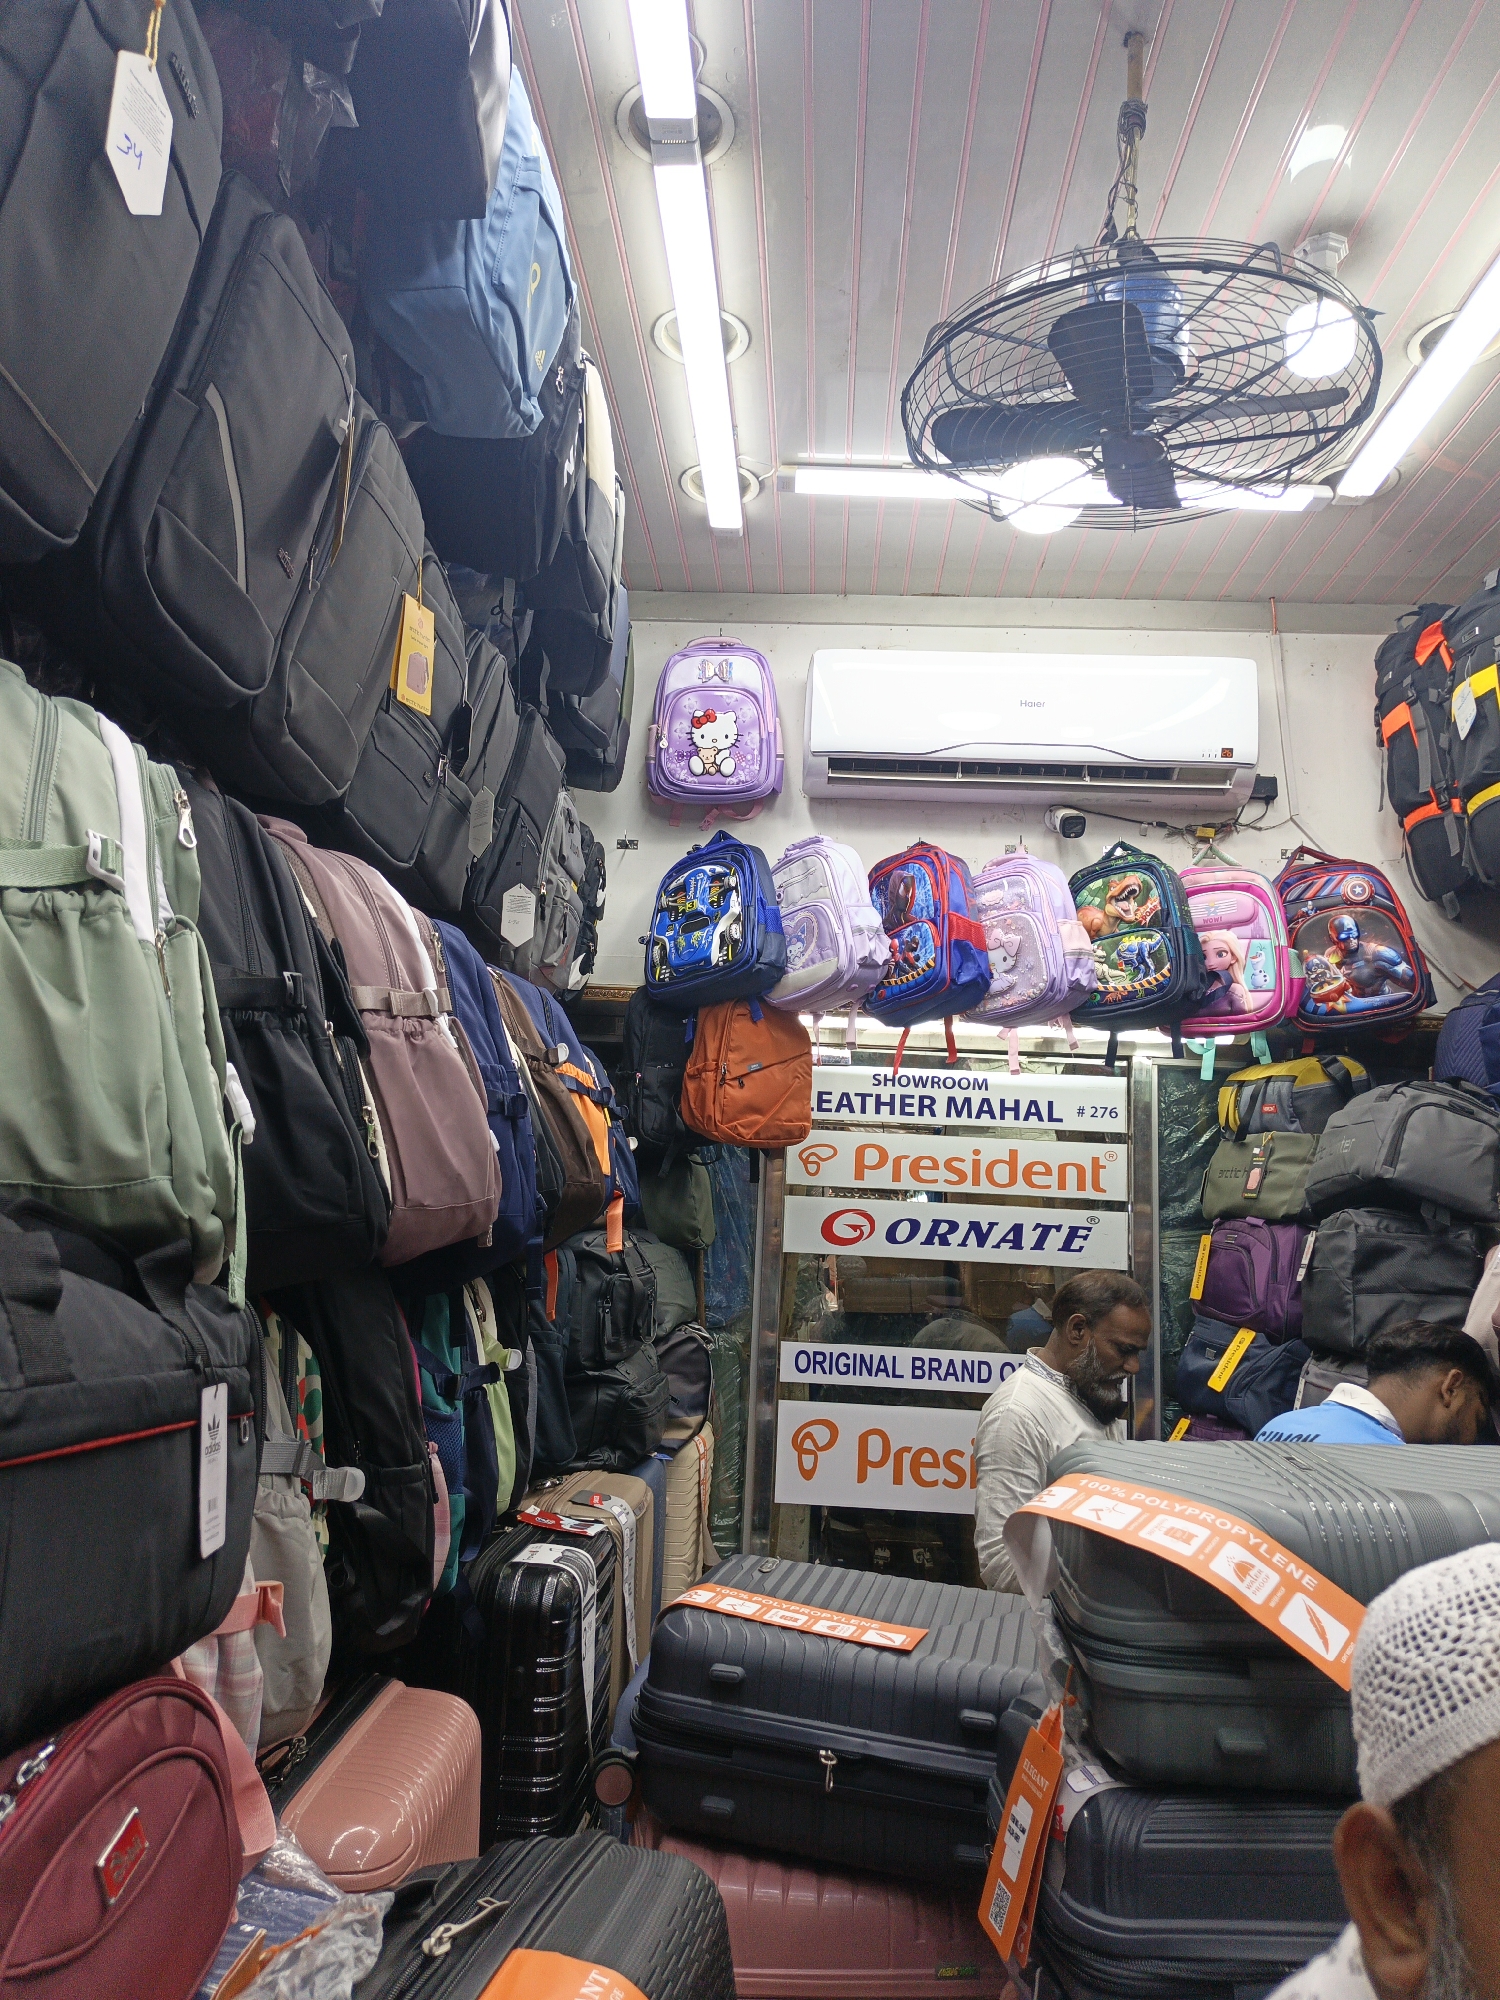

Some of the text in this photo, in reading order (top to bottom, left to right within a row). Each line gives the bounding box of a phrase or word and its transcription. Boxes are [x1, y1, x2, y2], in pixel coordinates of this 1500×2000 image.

[116, 132, 143, 170] 34
[1020, 700, 1046, 708] Haier
[1221, 748, 1233, 758] 26
[1203, 916, 1223, 925] WOW!
[872, 1073, 989, 1092] SHOWROOM
[811, 1090, 937, 1118] EATHER
[945, 1095, 1064, 1123] MAHAL
[1089, 1106, 1119, 1119] 276
[794, 1350, 905, 1379] ORIGINAL
[911, 1356, 993, 1384] BRAND
[204, 1441, 222, 1455] adidas
[1078, 1478, 1127, 1498] 100%
[1130, 1491, 1319, 1592] POLYPROPYLENE
[1244, 1569, 1265, 1591] WATER
[1252, 1574, 1272, 1596] PROOF
[714, 1587, 882, 1629] 100% POLYPROPYLENE
[1022, 1757, 1050, 1792] ELEGANT
